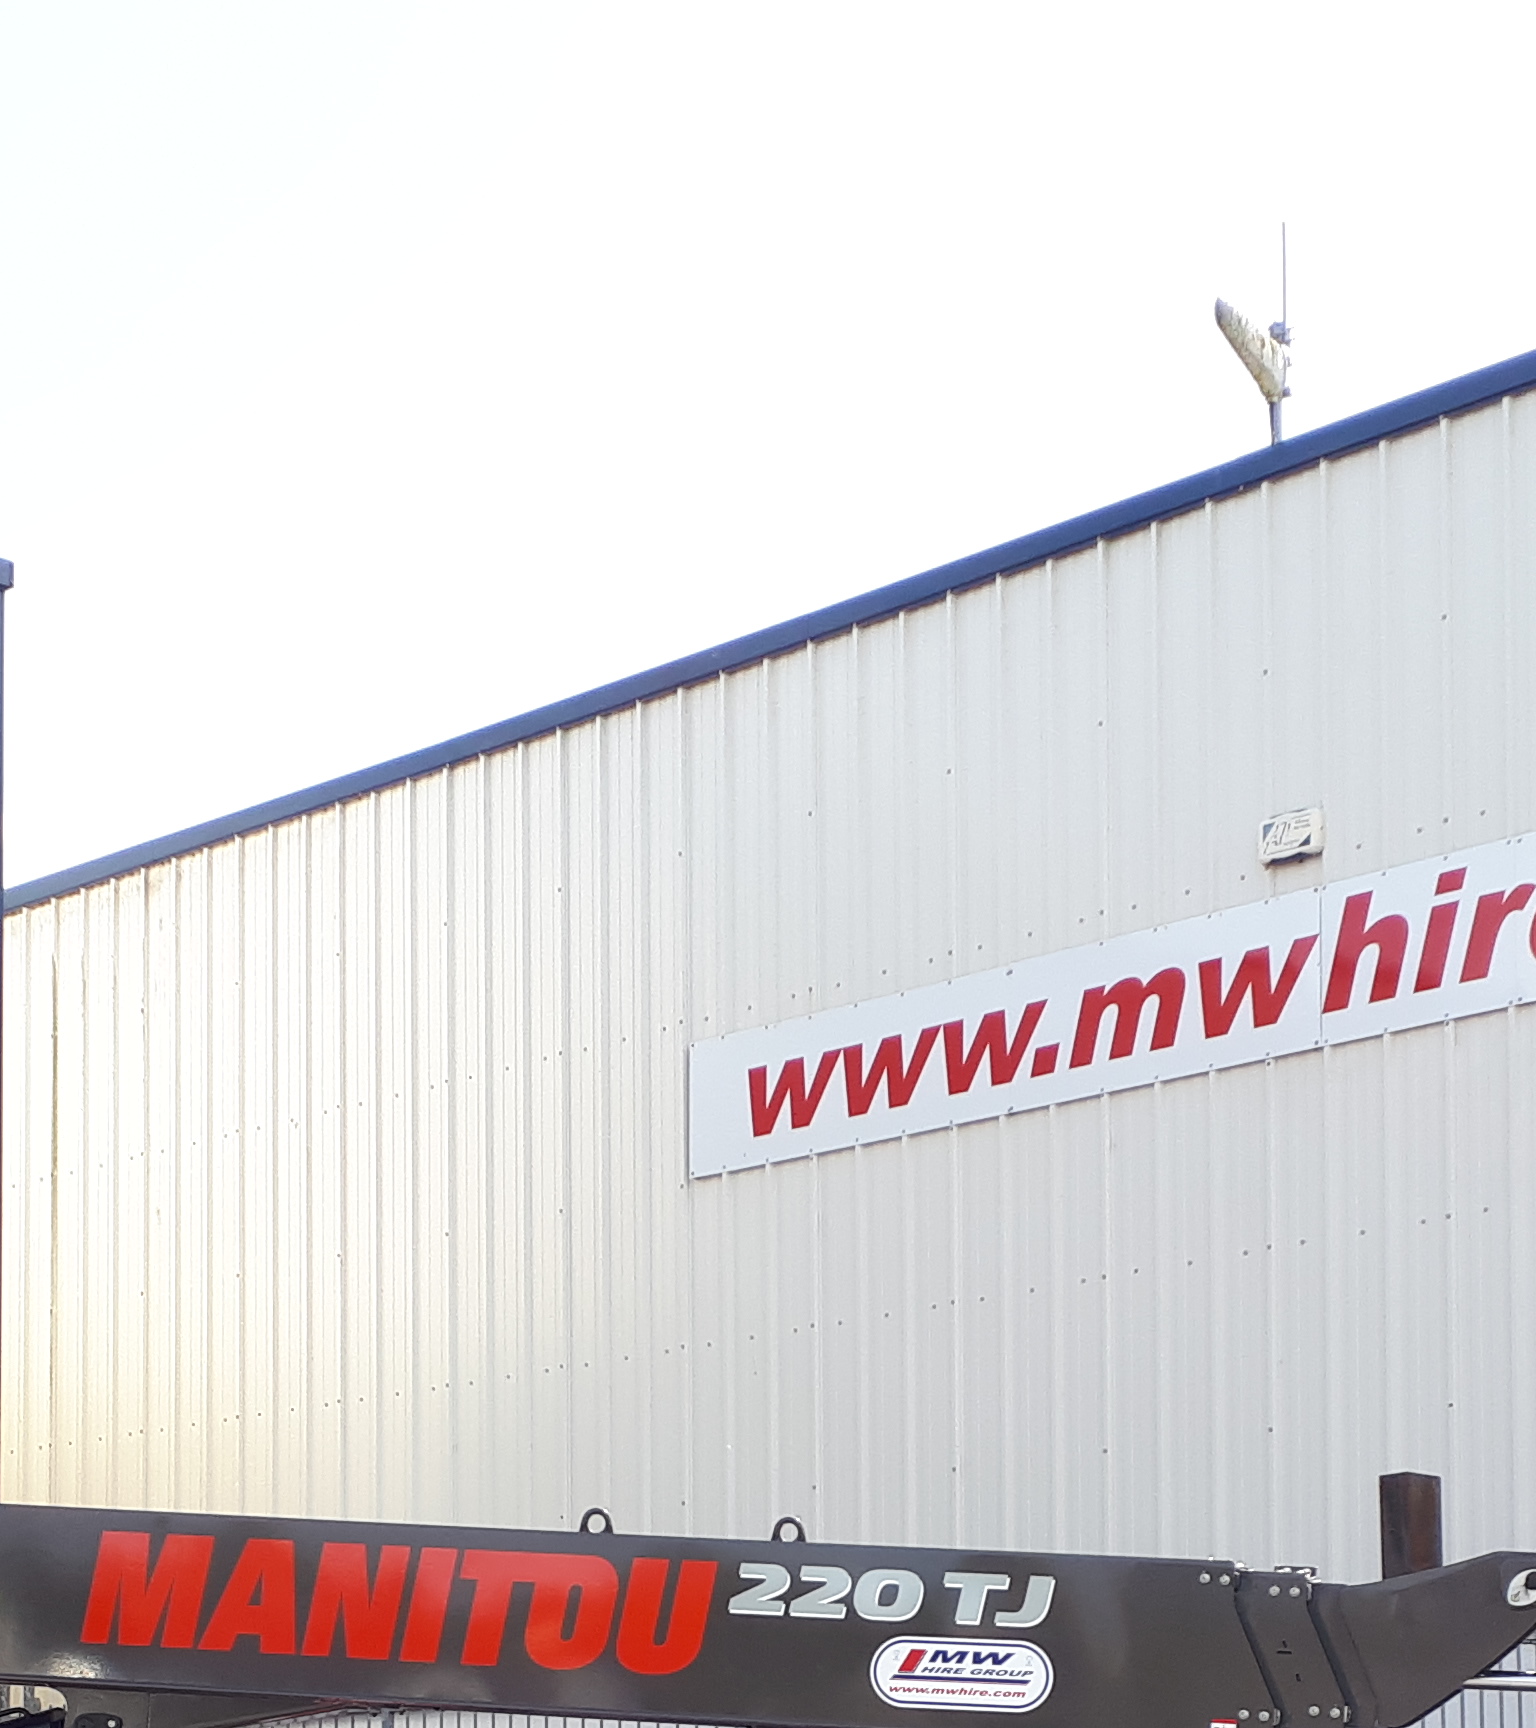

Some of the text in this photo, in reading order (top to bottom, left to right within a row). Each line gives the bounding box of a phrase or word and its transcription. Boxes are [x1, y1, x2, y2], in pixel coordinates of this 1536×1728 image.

[80, 1530, 719, 1675] MANITOU
[727, 1561, 1057, 1628] 220 TJ
[928, 1649, 1017, 1666] MW
[920, 1666, 1035, 1678] HIRE GROUP
[888, 1685, 1027, 1699] www.mwhire.com
